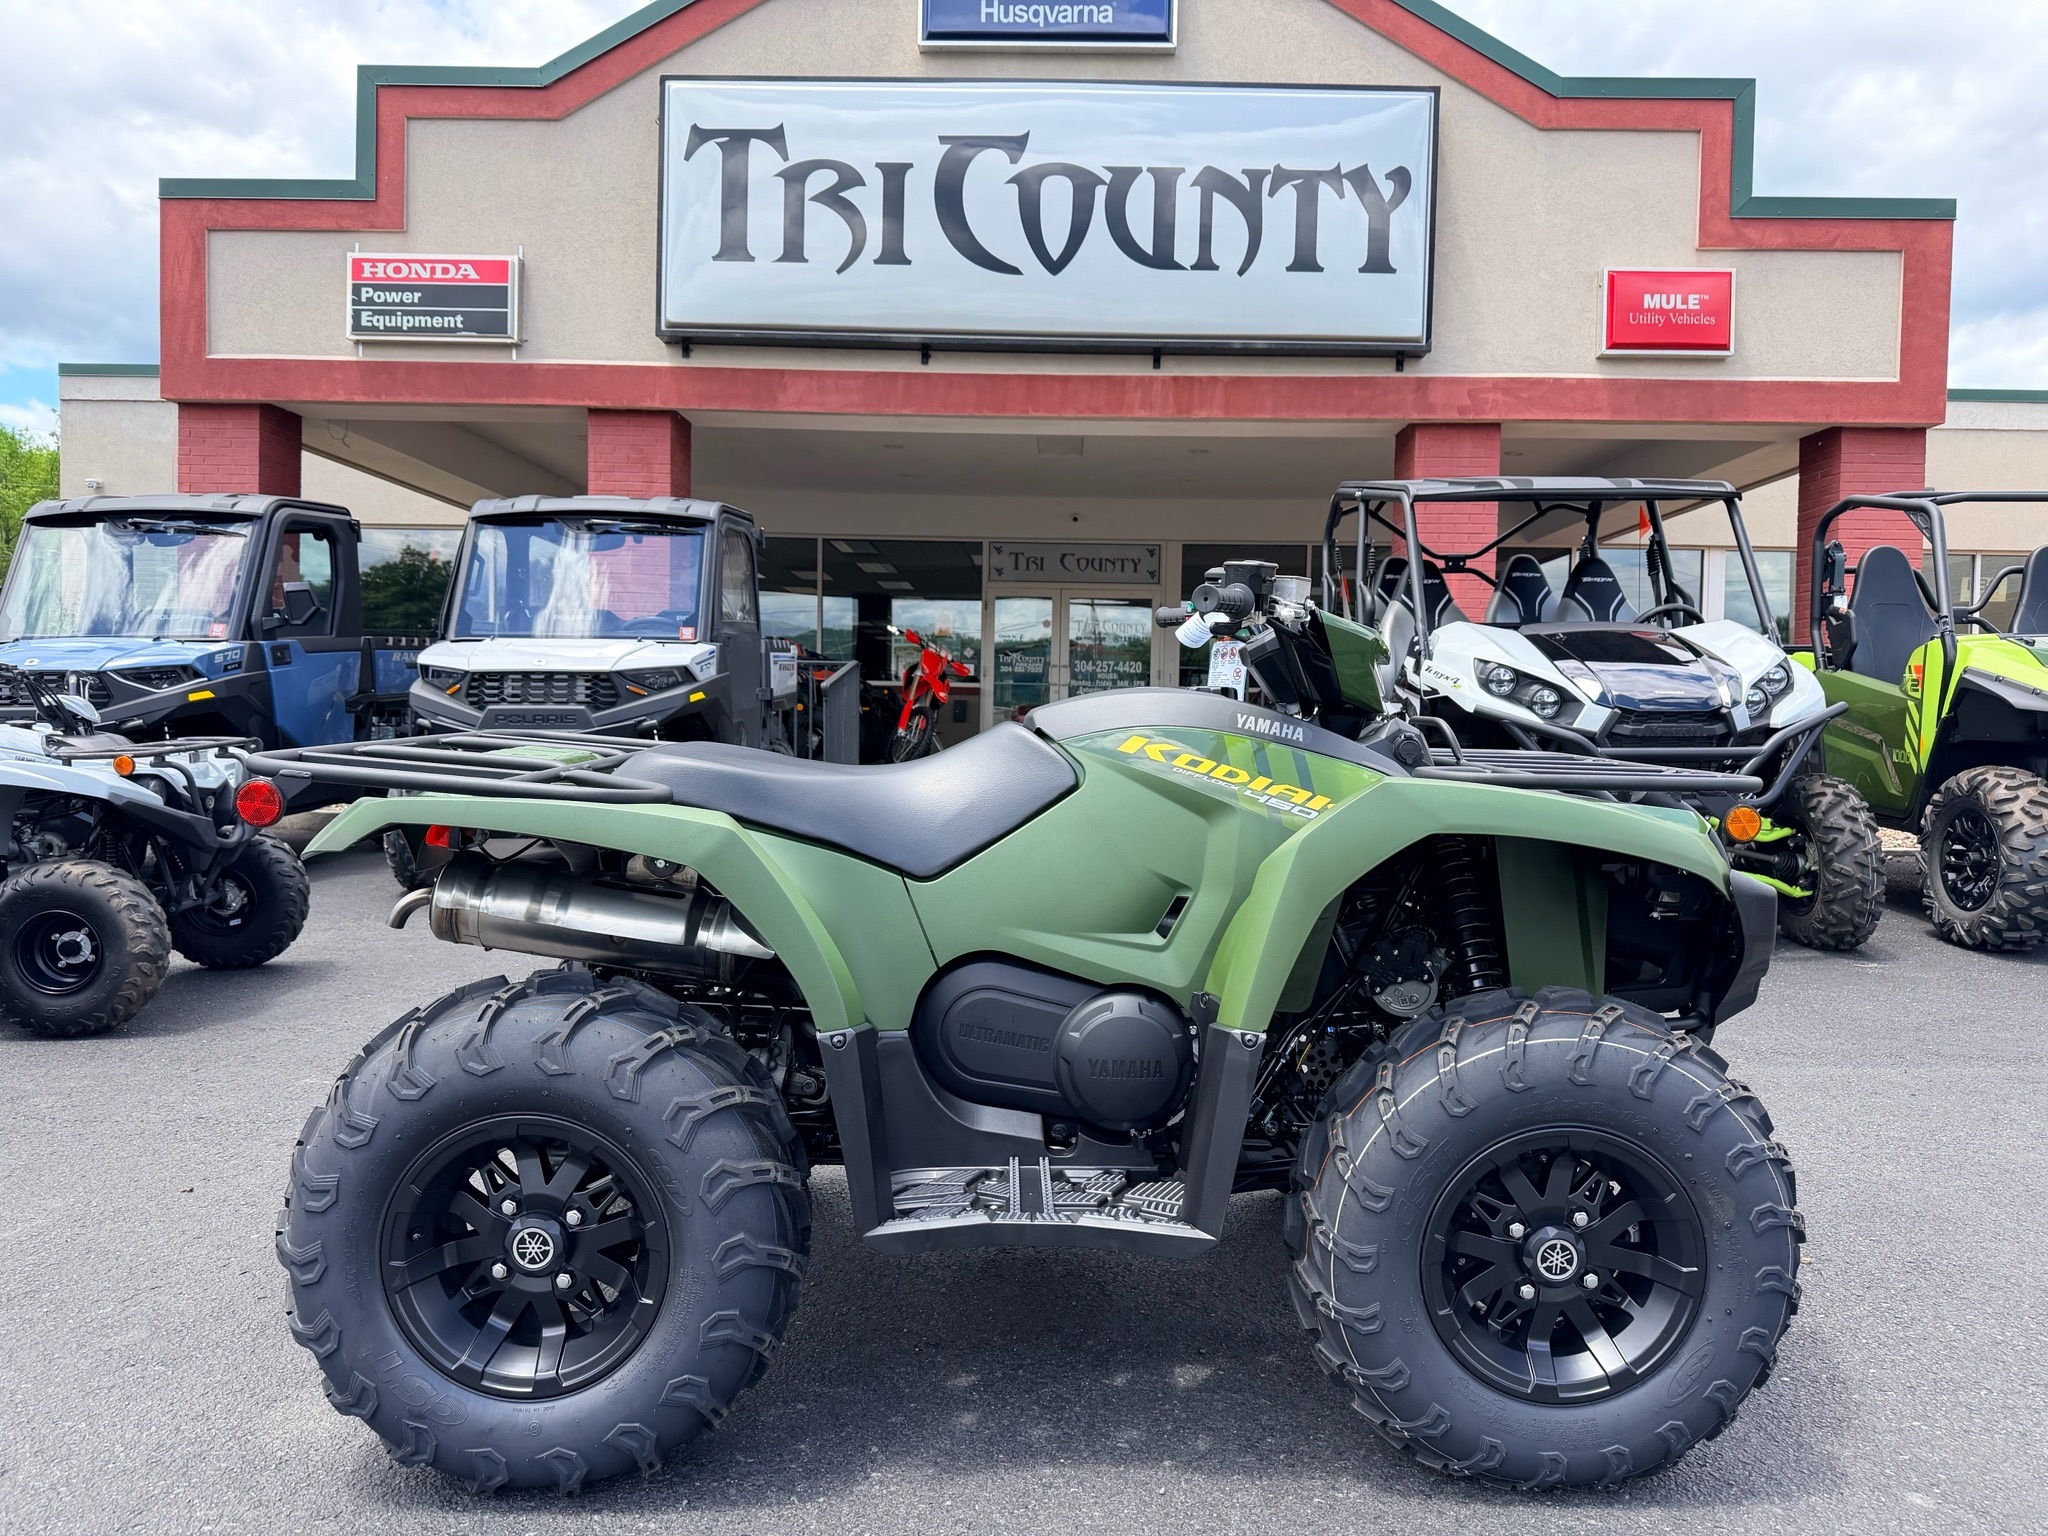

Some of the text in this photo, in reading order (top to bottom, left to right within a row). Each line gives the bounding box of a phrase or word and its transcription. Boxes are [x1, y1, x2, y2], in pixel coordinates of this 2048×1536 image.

[981, 0, 1113, 27] Husqvarna
[684, 122, 1411, 277] TRI COUNTY
[361, 262, 480, 278] HONDA
[361, 287, 422, 303] Power
[361, 311, 464, 330] Equipment
[1629, 312, 1716, 327] Utility Vehicles
[1074, 660, 1142, 673] 304-257-4420
[494, 714, 578, 725] POLARIS
[1236, 713, 1304, 742] YAMAHA
[1172, 767, 1241, 791] DIFFLOCK
[1243, 789, 1320, 819] 450
[959, 1023, 1050, 1053] ULTRAMATIC
[1088, 1058, 1165, 1080] YAMAHA
